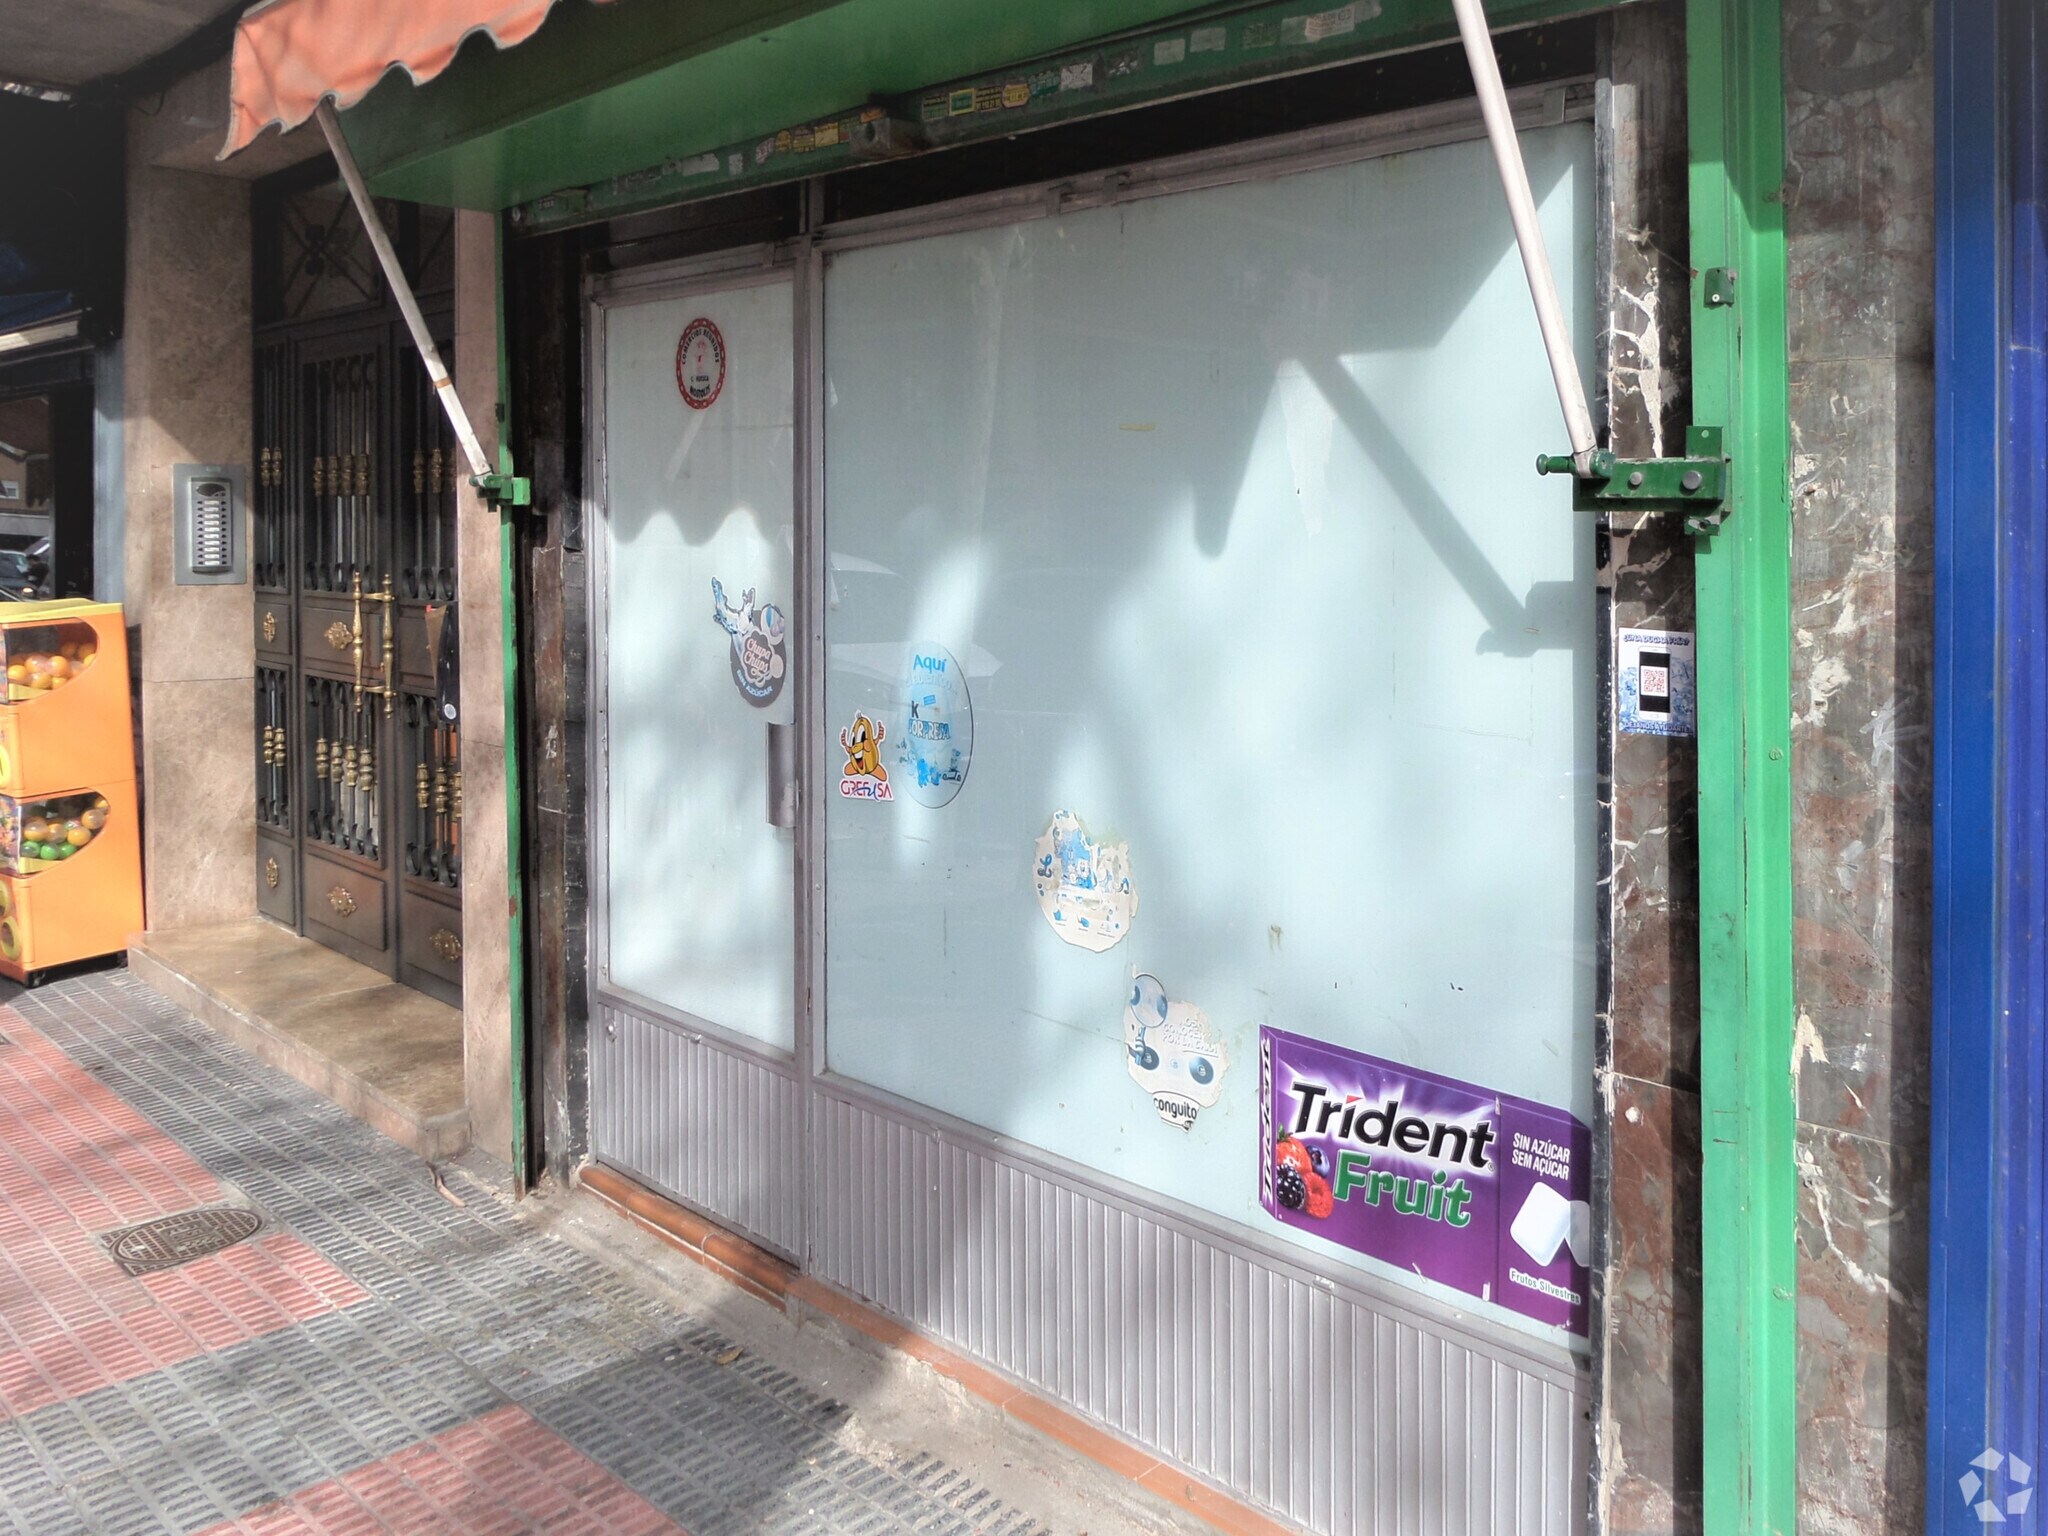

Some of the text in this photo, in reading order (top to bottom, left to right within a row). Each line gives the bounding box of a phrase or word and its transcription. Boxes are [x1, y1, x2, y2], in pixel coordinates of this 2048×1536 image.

[744, 650, 769, 674] Chups
[746, 638, 772, 659] Chupa
[913, 654, 947, 673] Aquí
[1292, 1082, 1494, 1168] Trident
[1512, 1132, 1571, 1164] SIN AZÚCAR
[1511, 1149, 1570, 1181] SEM AÇÚCAR
[1333, 1148, 1472, 1228] Fruit
[1511, 1270, 1581, 1304] Frutos Silvestres
